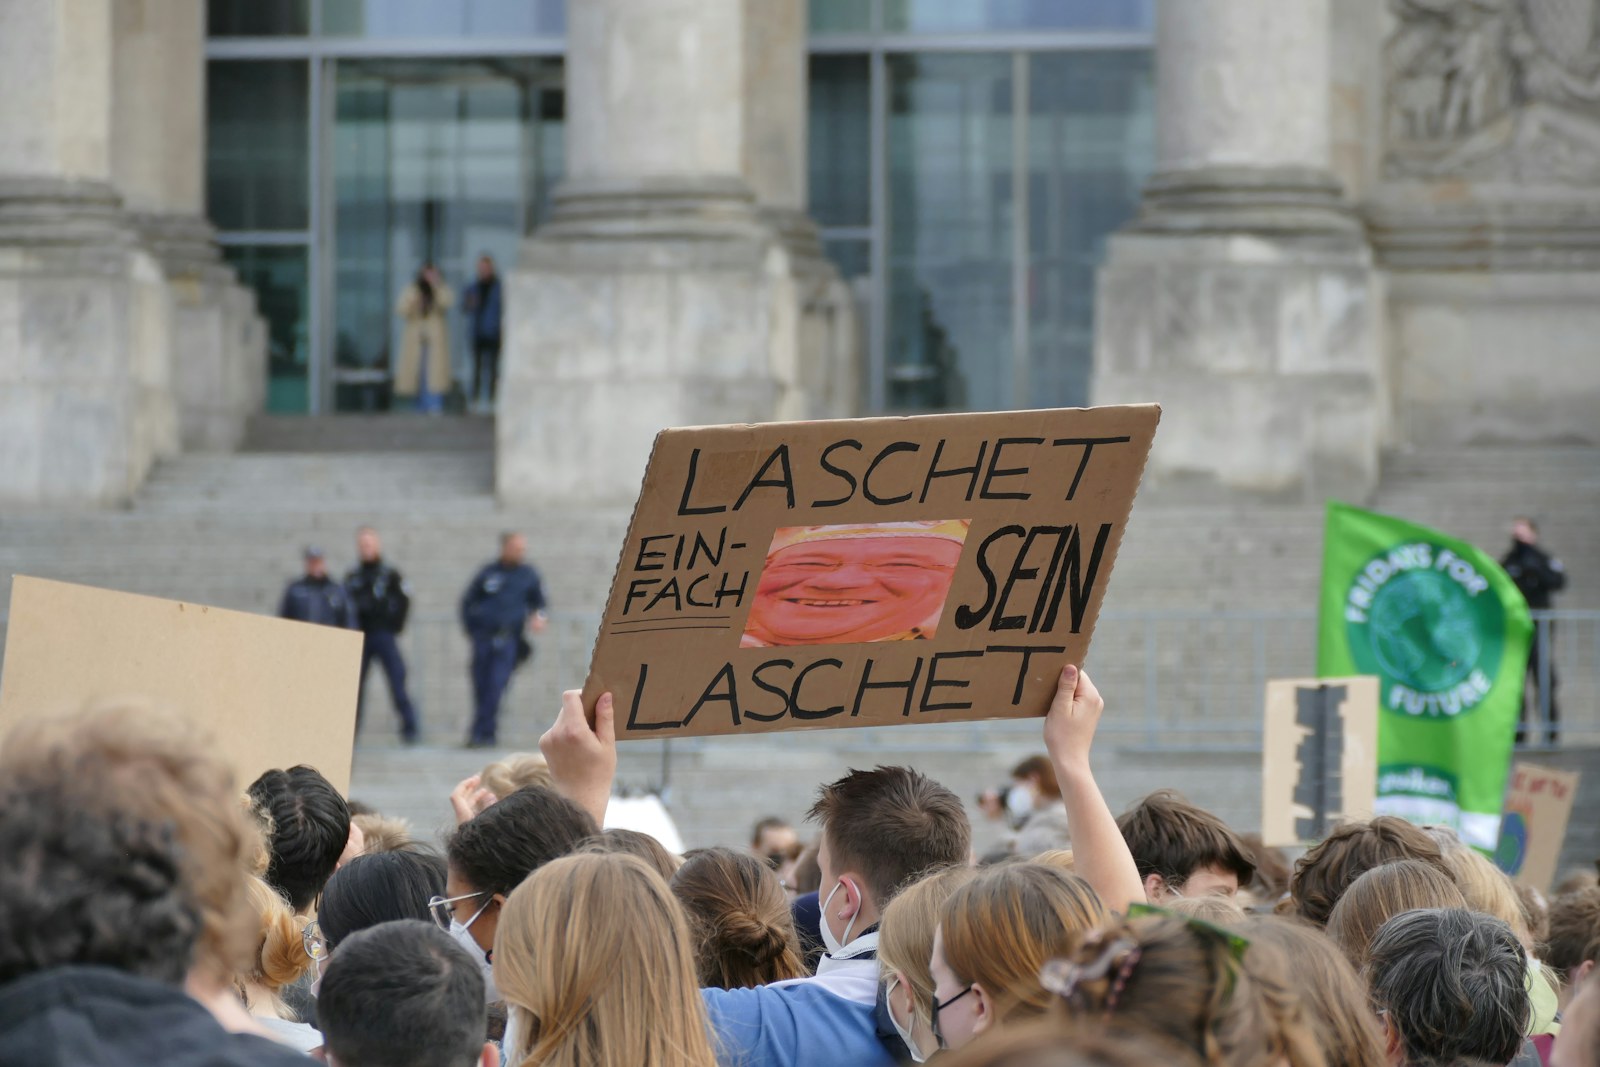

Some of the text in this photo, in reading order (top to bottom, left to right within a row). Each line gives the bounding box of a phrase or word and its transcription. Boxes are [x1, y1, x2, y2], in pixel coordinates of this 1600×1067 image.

[677, 435, 1131, 517] LASCHET
[633, 526, 747, 572] EIN-
[954, 522, 1113, 635] SEIN
[1345, 543, 1489, 623] FRIDAYS FOR
[622, 570, 750, 616] FACH
[625, 645, 1067, 731] LASCHET
[1388, 667, 1492, 717] FUTURE
